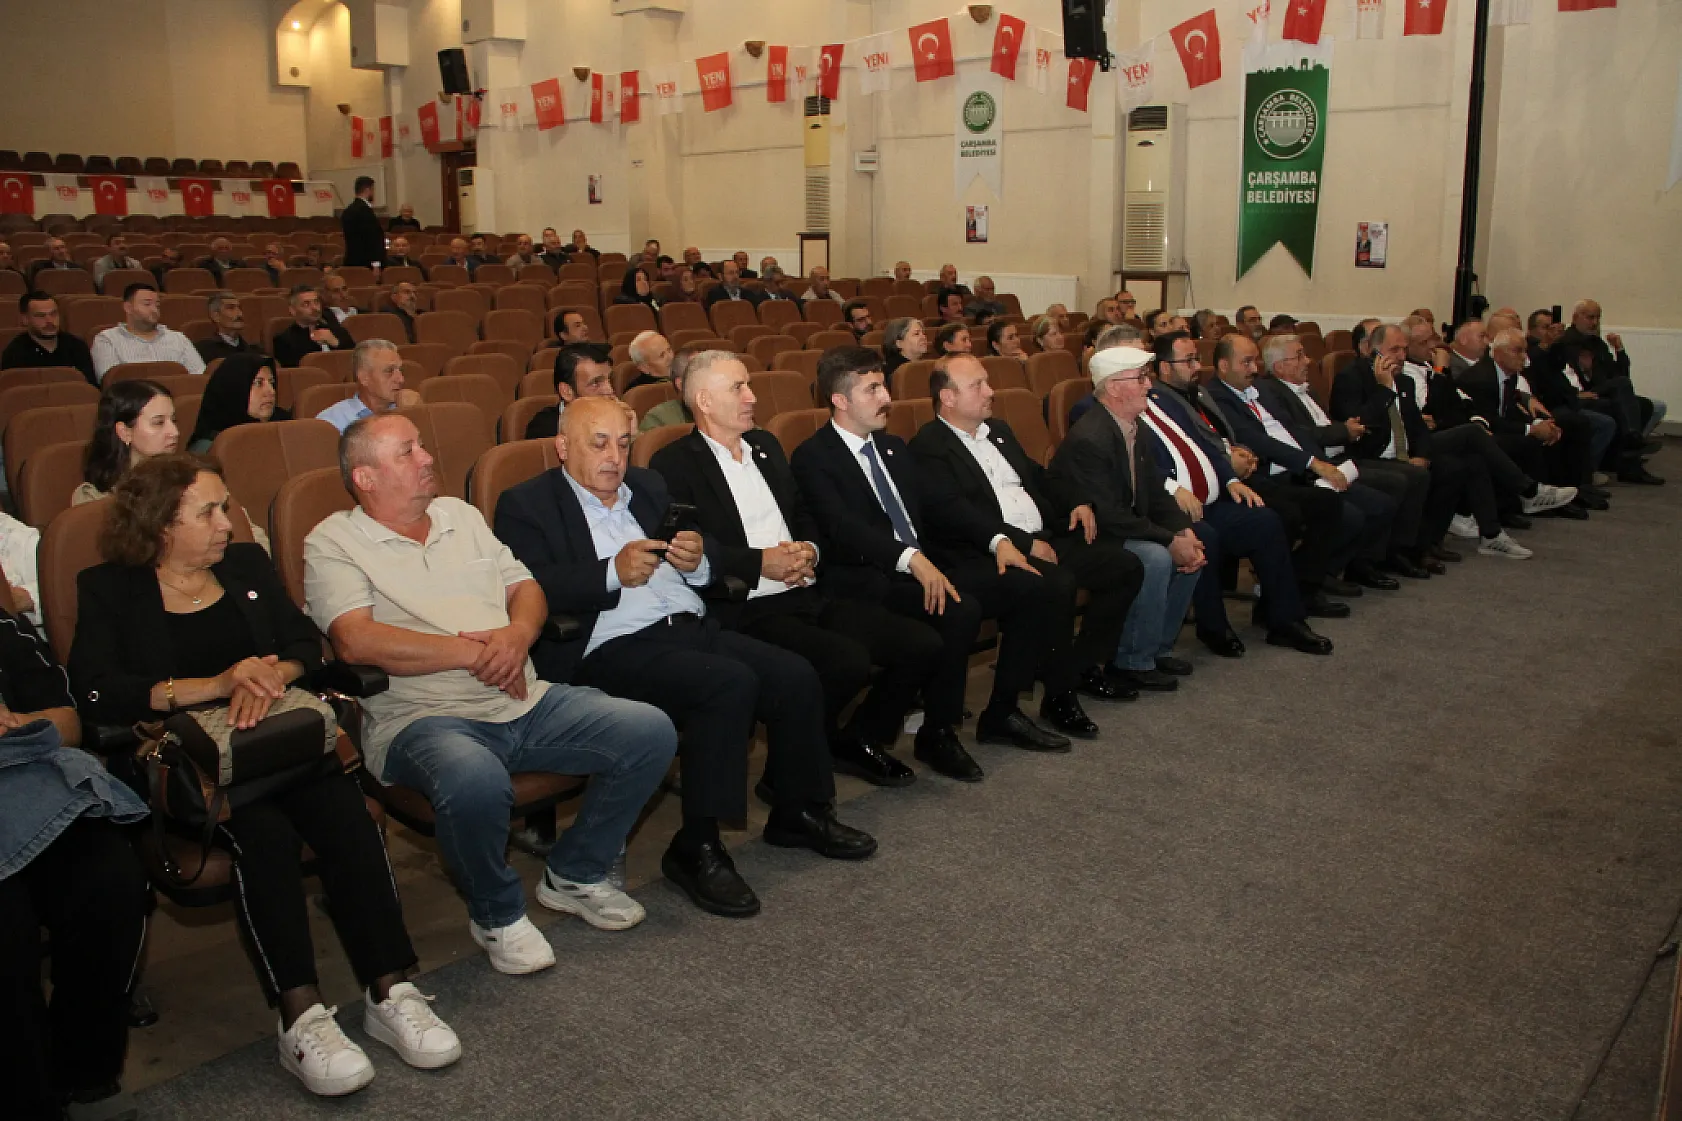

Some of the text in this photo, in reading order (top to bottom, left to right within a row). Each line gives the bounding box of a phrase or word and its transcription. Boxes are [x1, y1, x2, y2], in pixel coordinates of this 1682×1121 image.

[702, 71, 725, 85] YENI
[1248, 171, 1317, 188] ÇARŞAMBA
[1246, 188, 1316, 203] BELEDİYESİ
